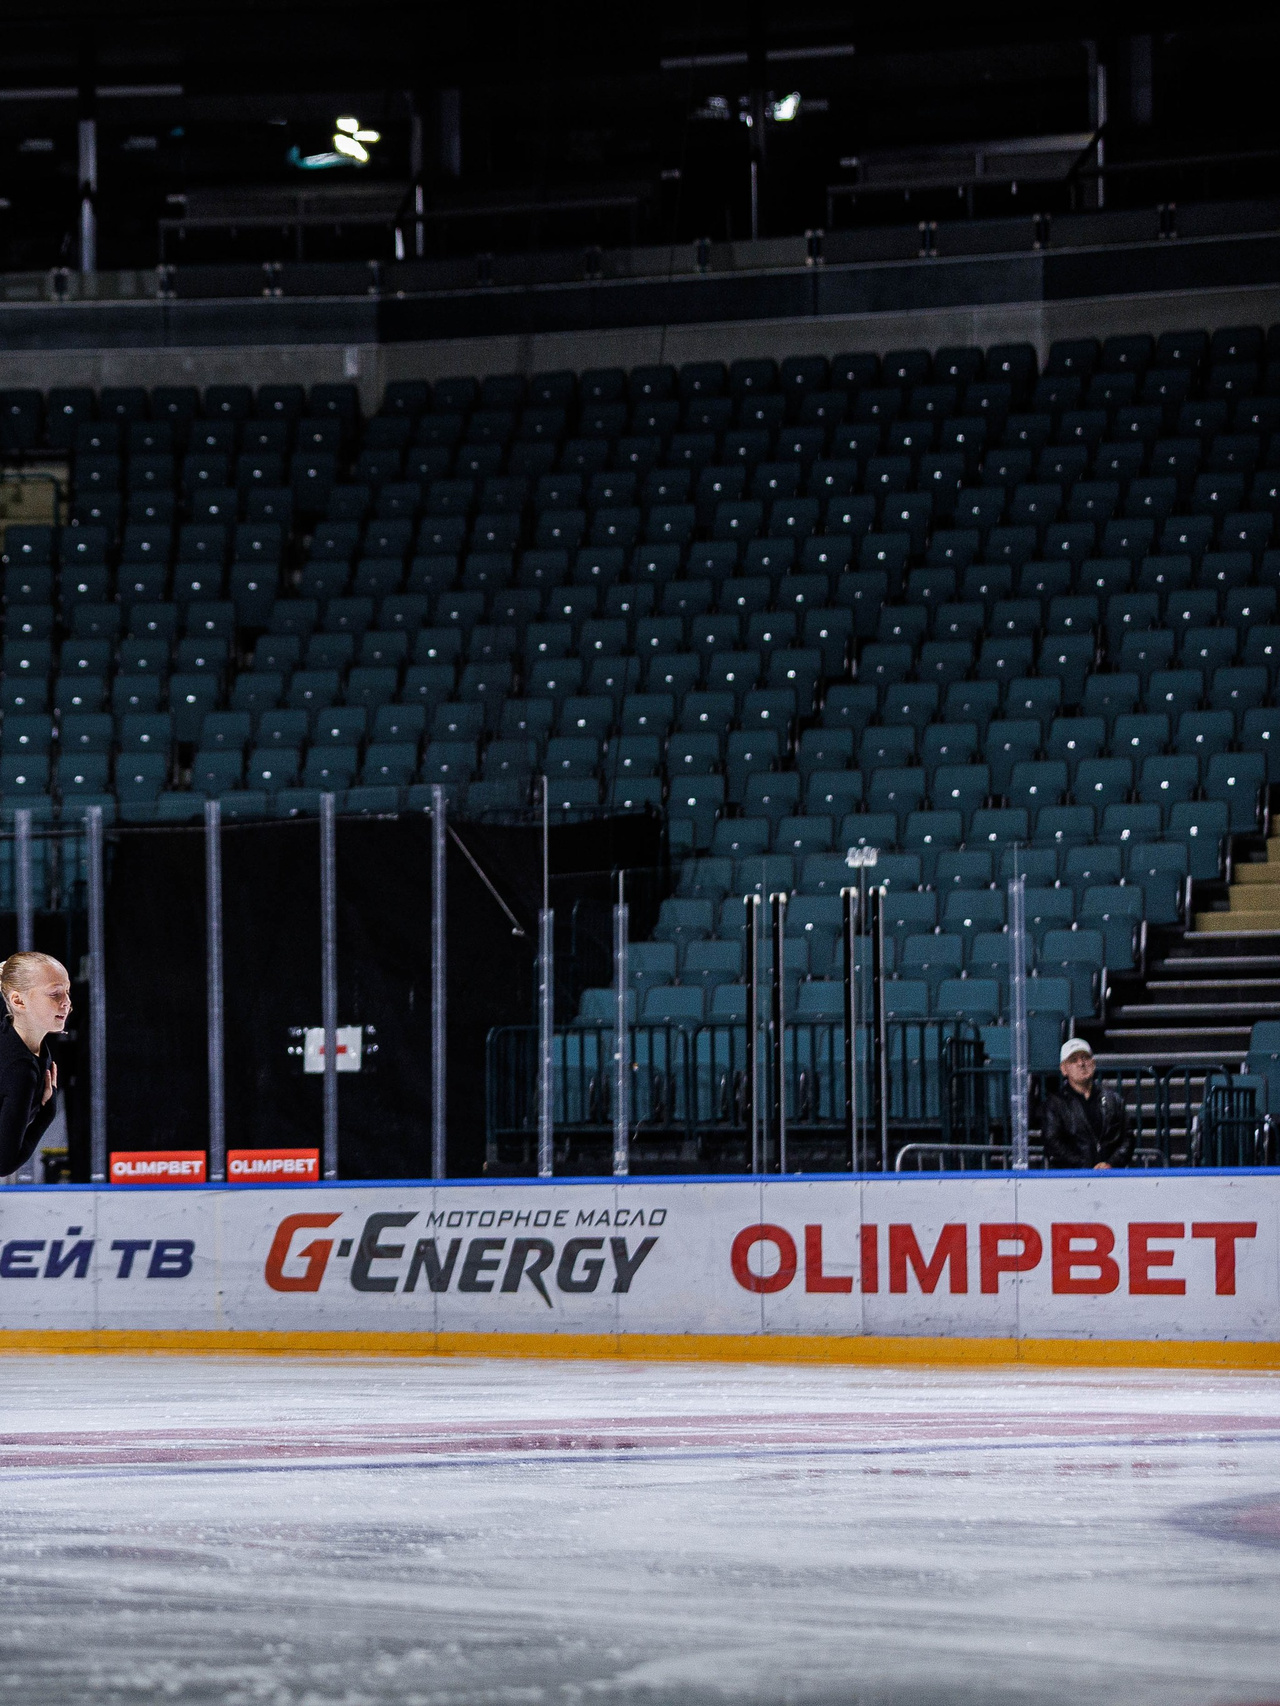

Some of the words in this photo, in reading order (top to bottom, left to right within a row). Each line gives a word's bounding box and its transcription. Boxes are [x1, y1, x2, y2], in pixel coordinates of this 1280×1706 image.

[112, 1160, 203, 1176] OLIMPBET
[229, 1158, 317, 1174] OLIMPBET
[425, 1209, 570, 1228] МОТОРНОЕ
[574, 1208, 668, 1227] МАСЛО
[110, 1239, 196, 1279] ТВ
[730, 1221, 1258, 1296] OLIMPBET
